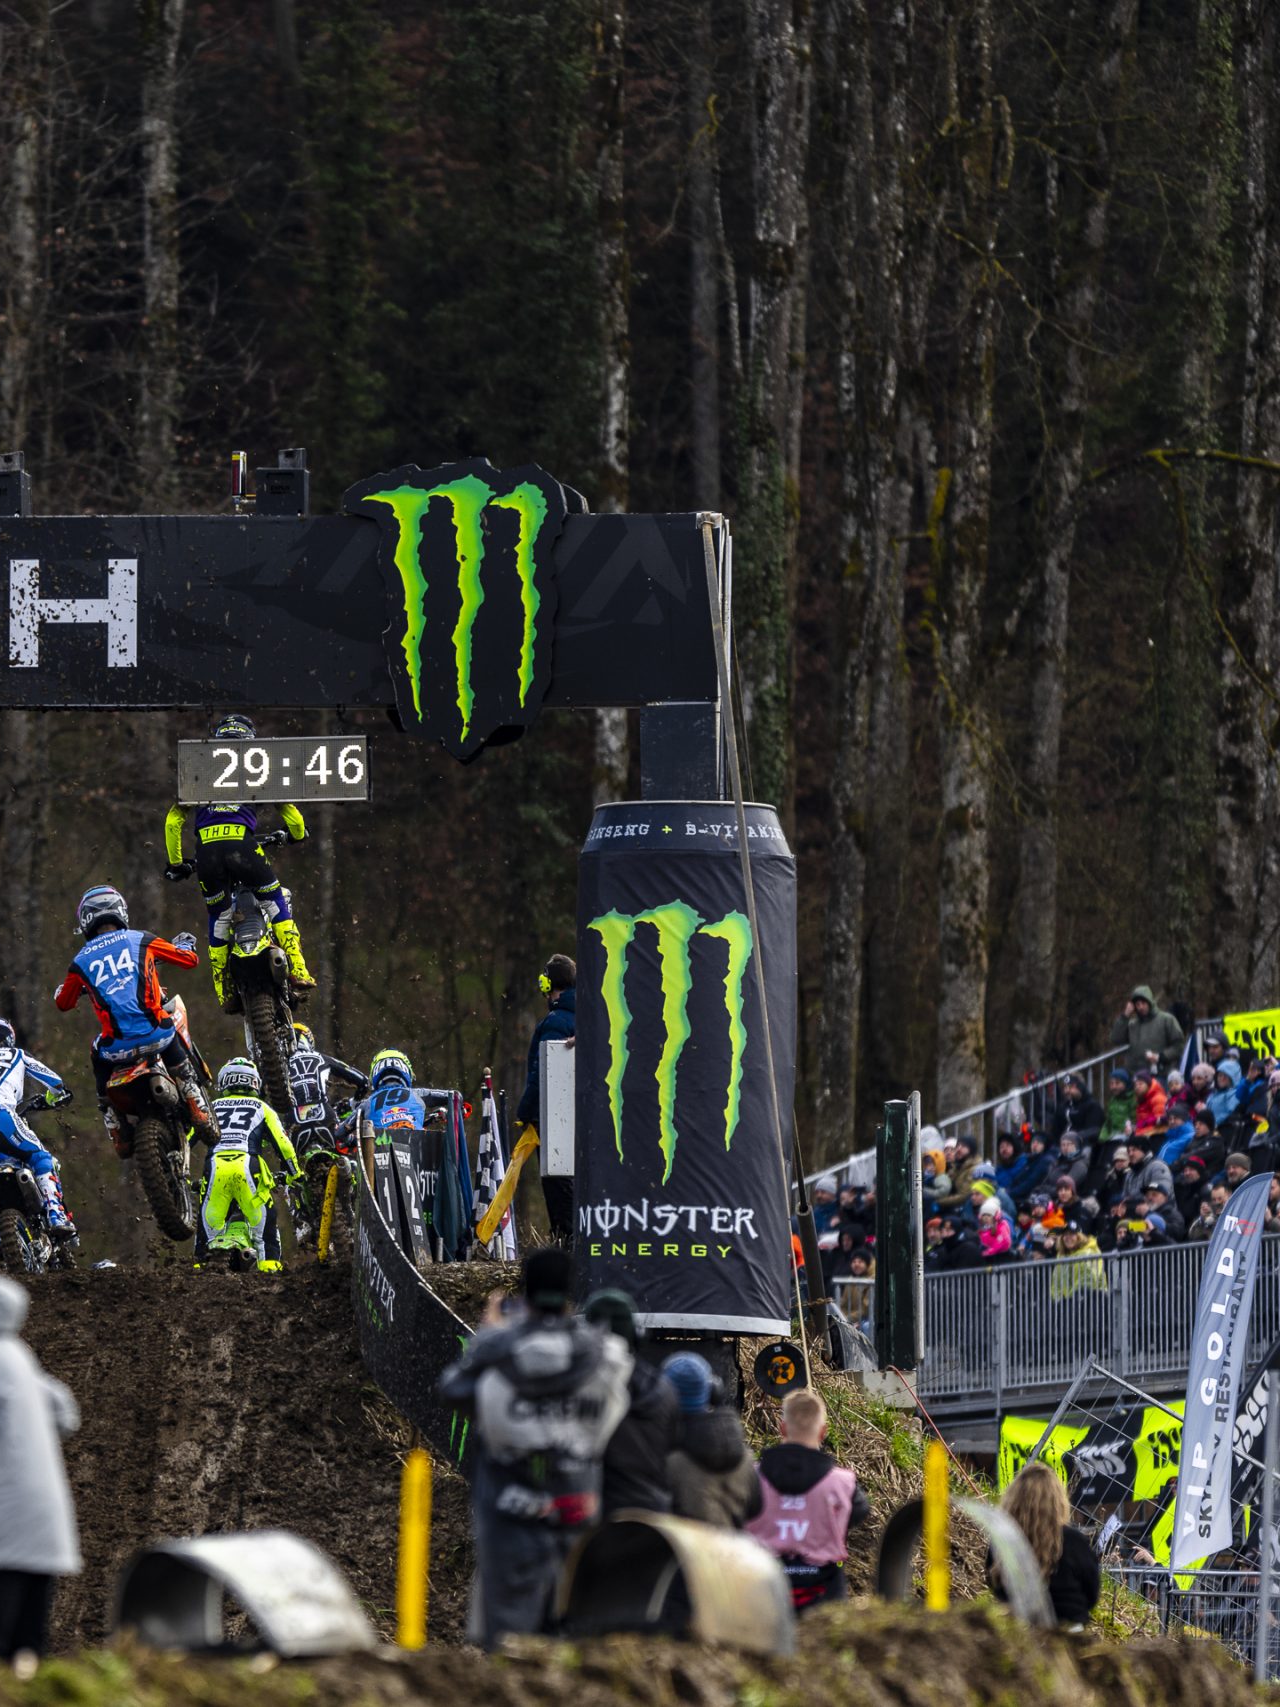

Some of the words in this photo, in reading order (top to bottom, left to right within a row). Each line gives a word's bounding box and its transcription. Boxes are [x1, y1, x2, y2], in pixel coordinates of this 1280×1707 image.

[212, 745, 365, 788] 29:46
[83, 933, 128, 955] Oechslin
[89, 949, 135, 987] 214
[215, 1107, 257, 1131] 33
[372, 1088, 411, 1113] 19
[383, 1177, 394, 1221] 1
[406, 1175, 420, 1219] 2
[579, 1197, 759, 1239] MONSTER
[590, 1243, 732, 1258] ENERGY
[1182, 1442, 1208, 1537] VIP
[1200, 1247, 1235, 1406] GOLD
[775, 1519, 810, 1542] TV
